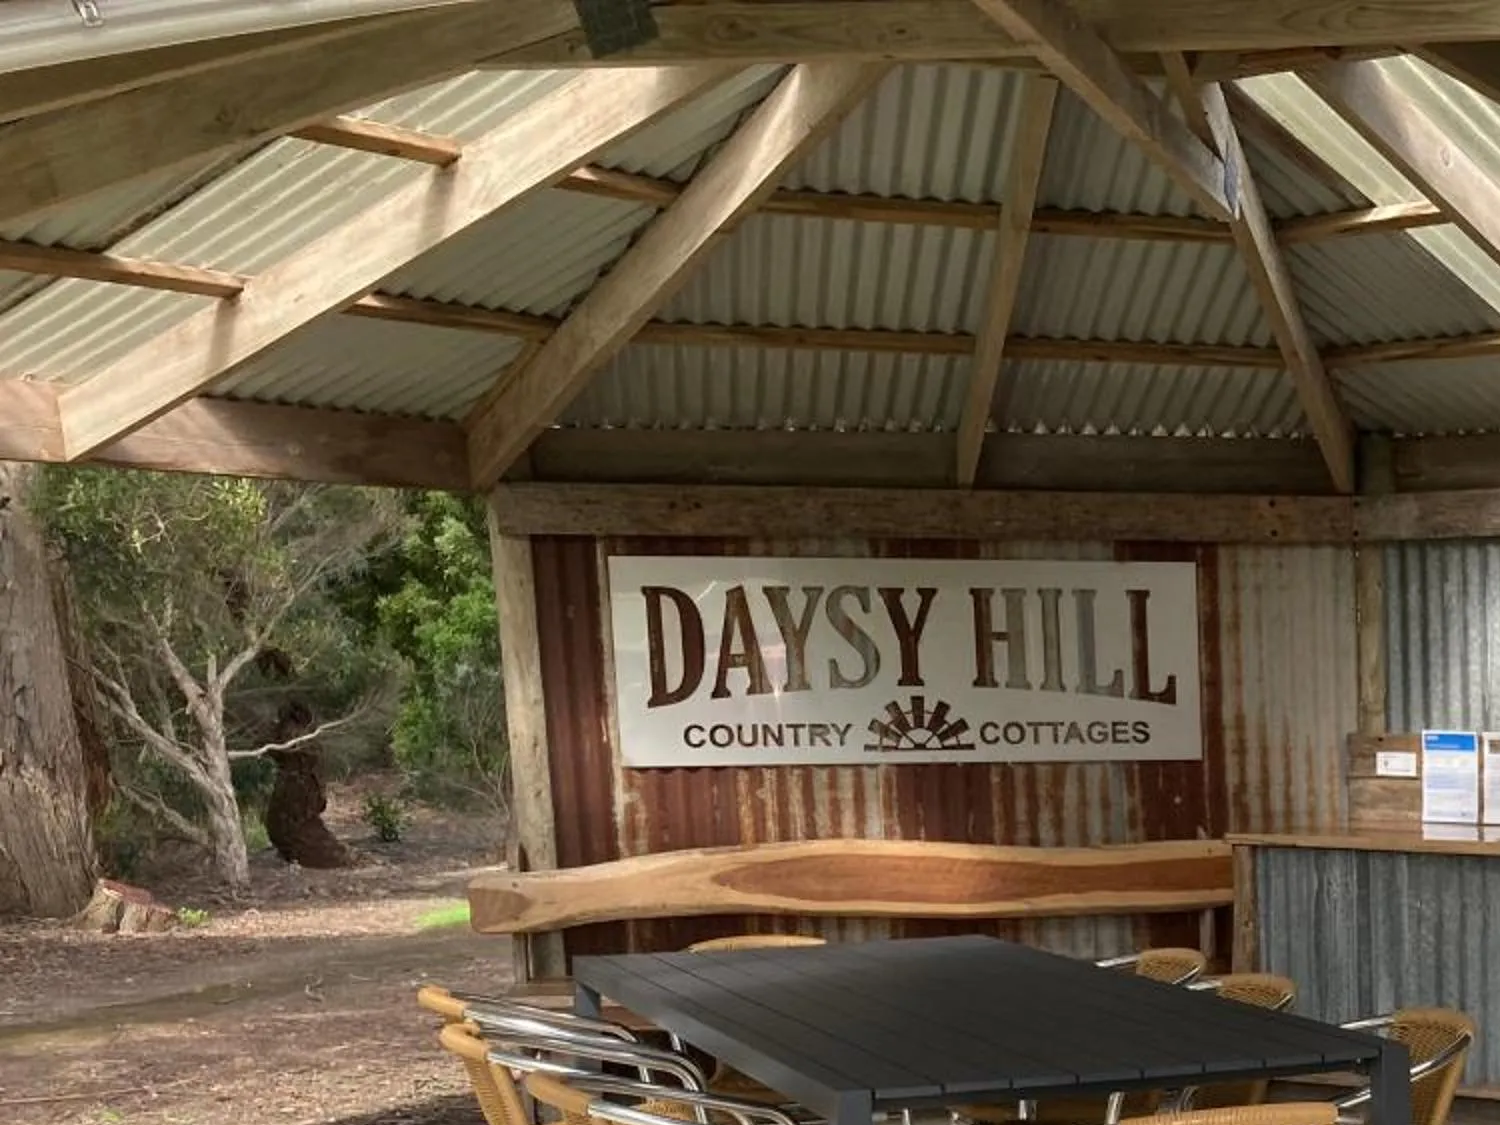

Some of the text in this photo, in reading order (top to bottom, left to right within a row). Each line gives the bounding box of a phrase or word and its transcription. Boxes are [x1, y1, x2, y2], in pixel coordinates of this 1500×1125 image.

[641, 584, 1177, 708] DAYSY HILL
[683, 720, 1151, 749] COUNTRY COTTAGES
